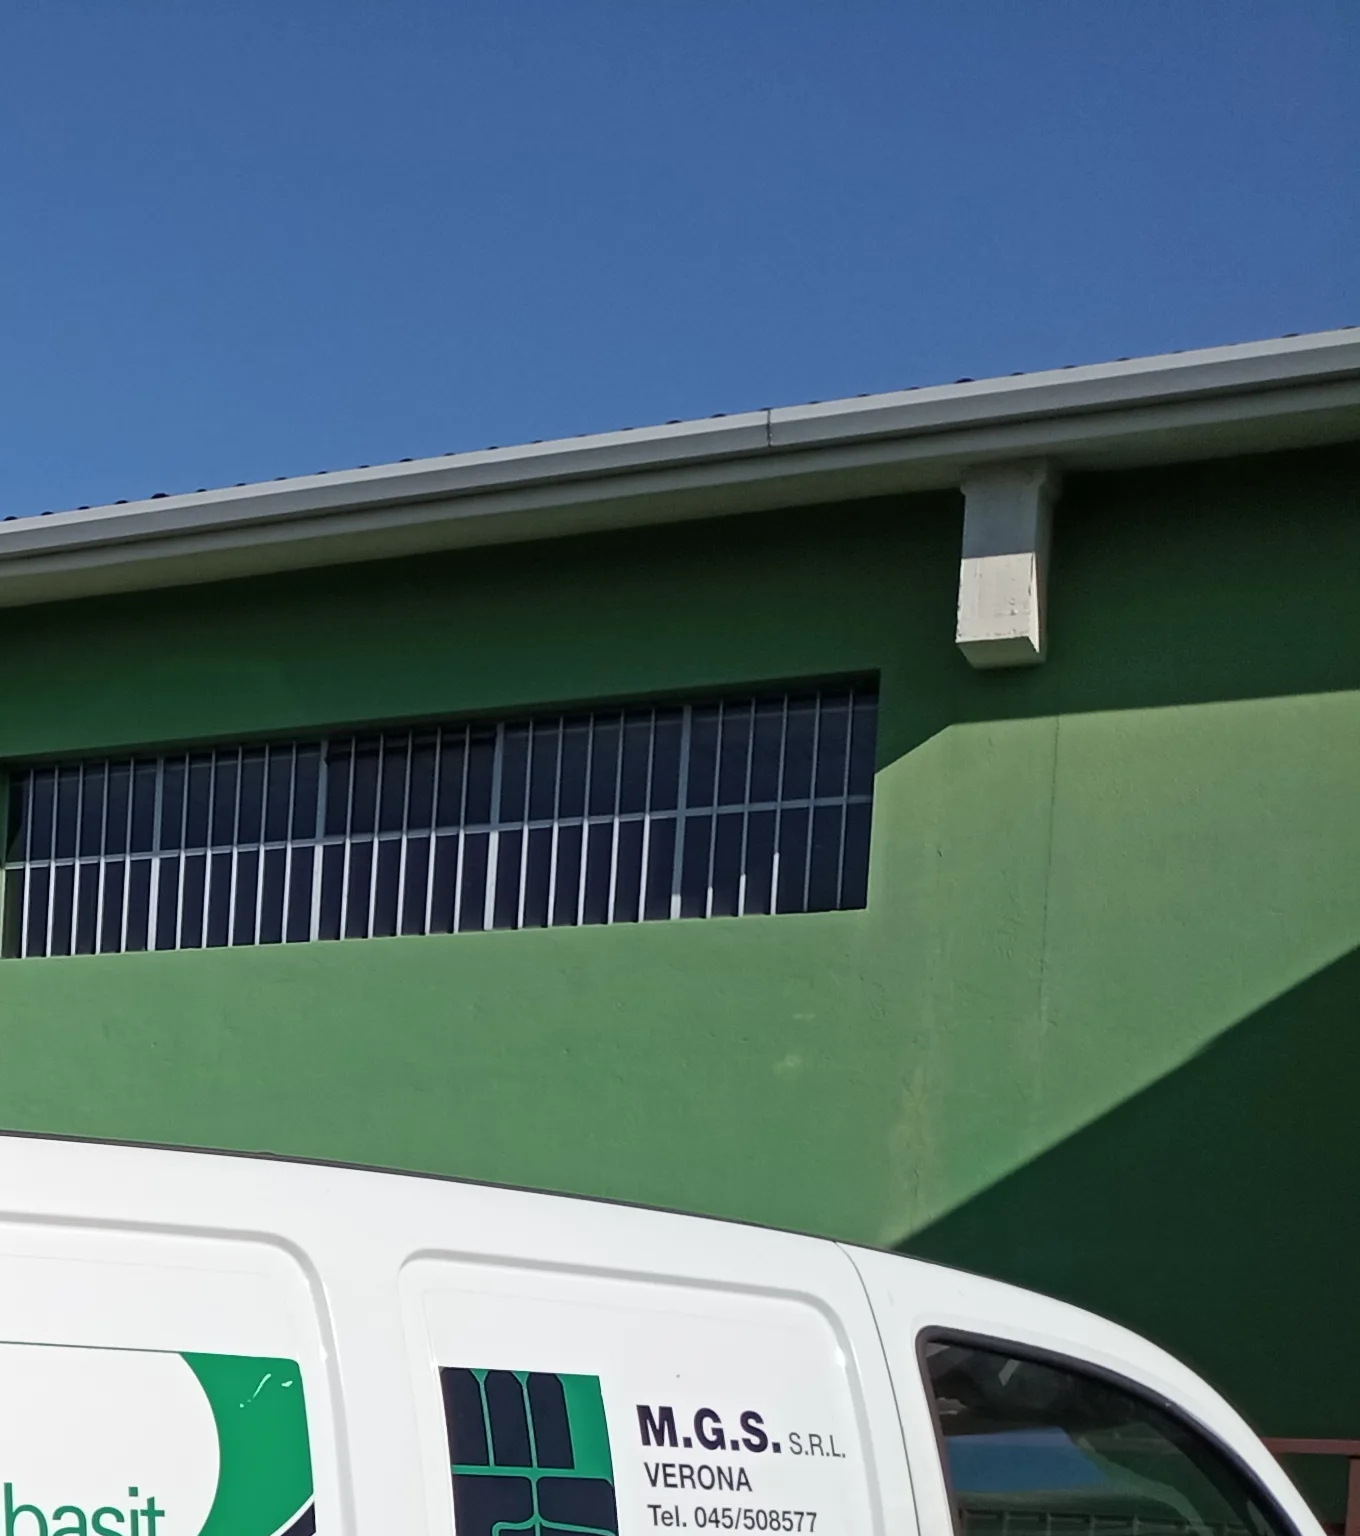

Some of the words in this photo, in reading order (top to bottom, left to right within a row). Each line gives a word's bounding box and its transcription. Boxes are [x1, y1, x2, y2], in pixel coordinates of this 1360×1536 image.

[635, 1404, 782, 1454] M.G.S.
[789, 1432, 847, 1459] S.R.L.
[644, 1462, 753, 1493] VERONA
[647, 1504, 688, 1528] Tel.
[694, 1507, 818, 1532] 045/508577
